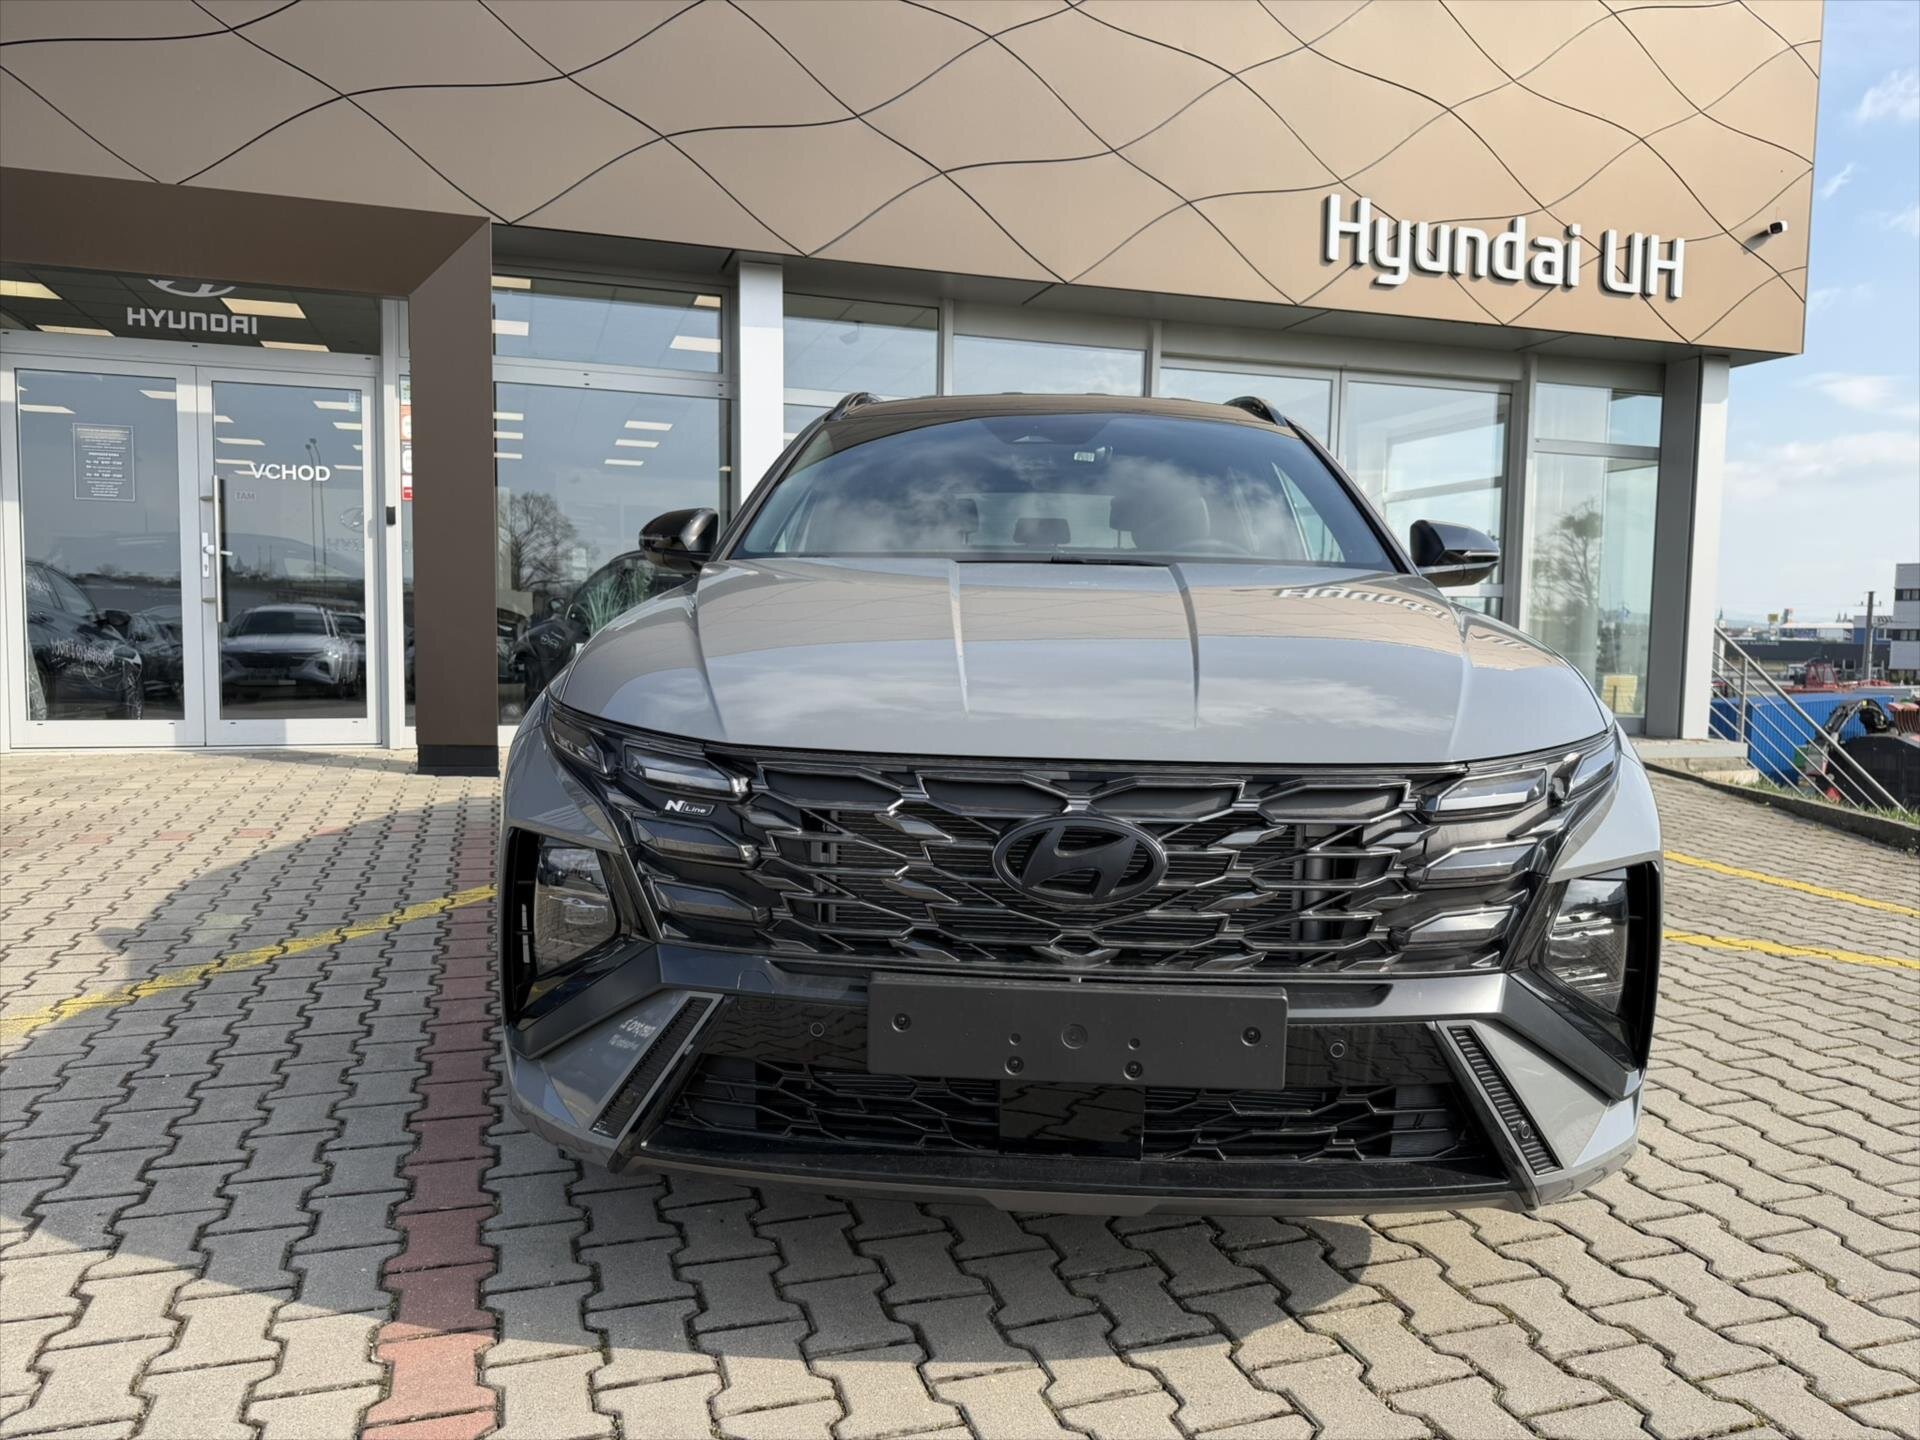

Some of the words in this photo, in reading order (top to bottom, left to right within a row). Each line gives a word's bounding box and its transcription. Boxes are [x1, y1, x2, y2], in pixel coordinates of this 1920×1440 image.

[1325, 193, 1581, 286] Hyundai
[1602, 228, 1685, 298] UH
[126, 306, 258, 335] HYUNDAI
[250, 463, 331, 482] VCHOD
[685, 805, 706, 814] Line
